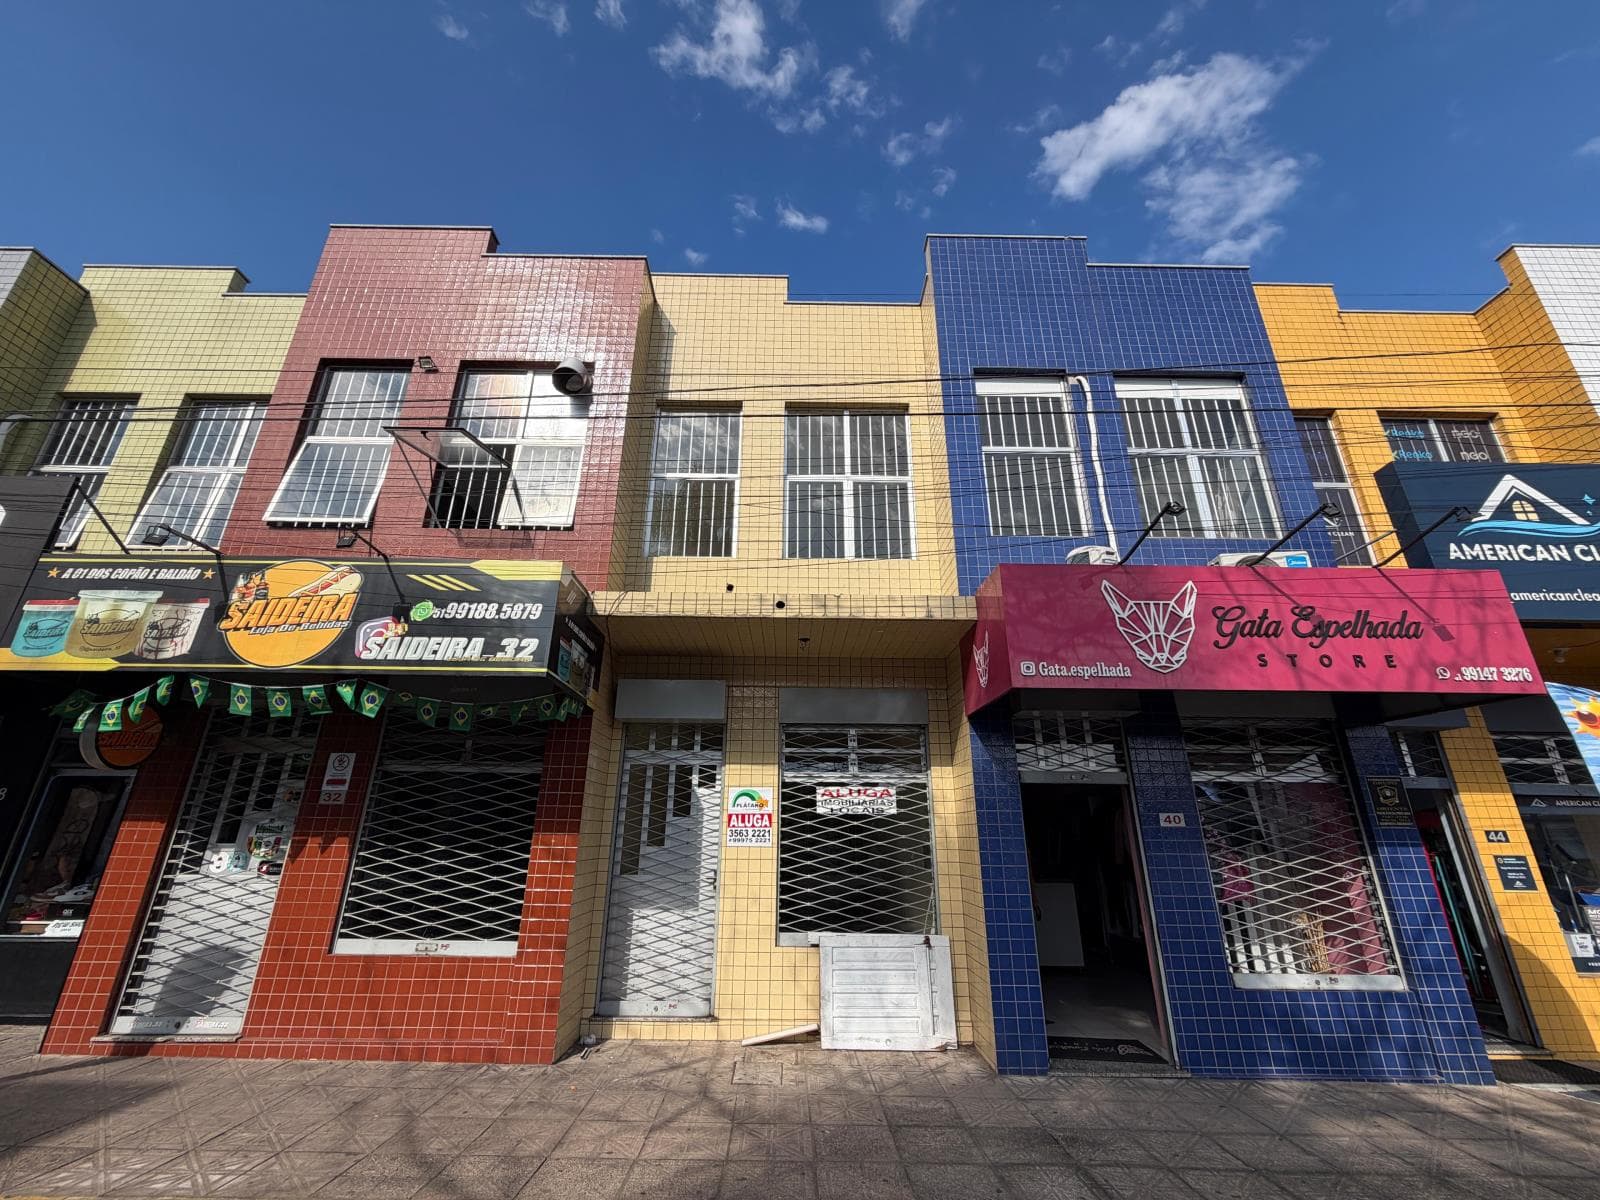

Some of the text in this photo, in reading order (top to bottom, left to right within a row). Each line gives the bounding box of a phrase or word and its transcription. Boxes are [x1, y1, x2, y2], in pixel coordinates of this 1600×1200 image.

[1449, 543, 1571, 562] AMERICAN
[61, 568, 72, 579] A
[86, 568, 110, 579] DOS
[110, 567, 150, 580] COPÃO
[148, 568, 158, 579] E
[156, 567, 202, 580] BALDÃO
[1510, 588, 1600, 603] americanclea
[221, 594, 361, 631] SAIDEIRA
[249, 620, 350, 636] Loja De Bebidas
[1211, 605, 1425, 649] Gata Espelhada
[1258, 653, 1398, 668] STORE
[1039, 662, 1132, 679] Gata.espelhada
[322, 792, 342, 802] 32
[820, 788, 893, 798] ALUGA
[729, 814, 771, 827] ALUGA
[1163, 814, 1182, 825] 40
[728, 829, 771, 838] 3563 2221
[1488, 831, 1506, 842] 44
